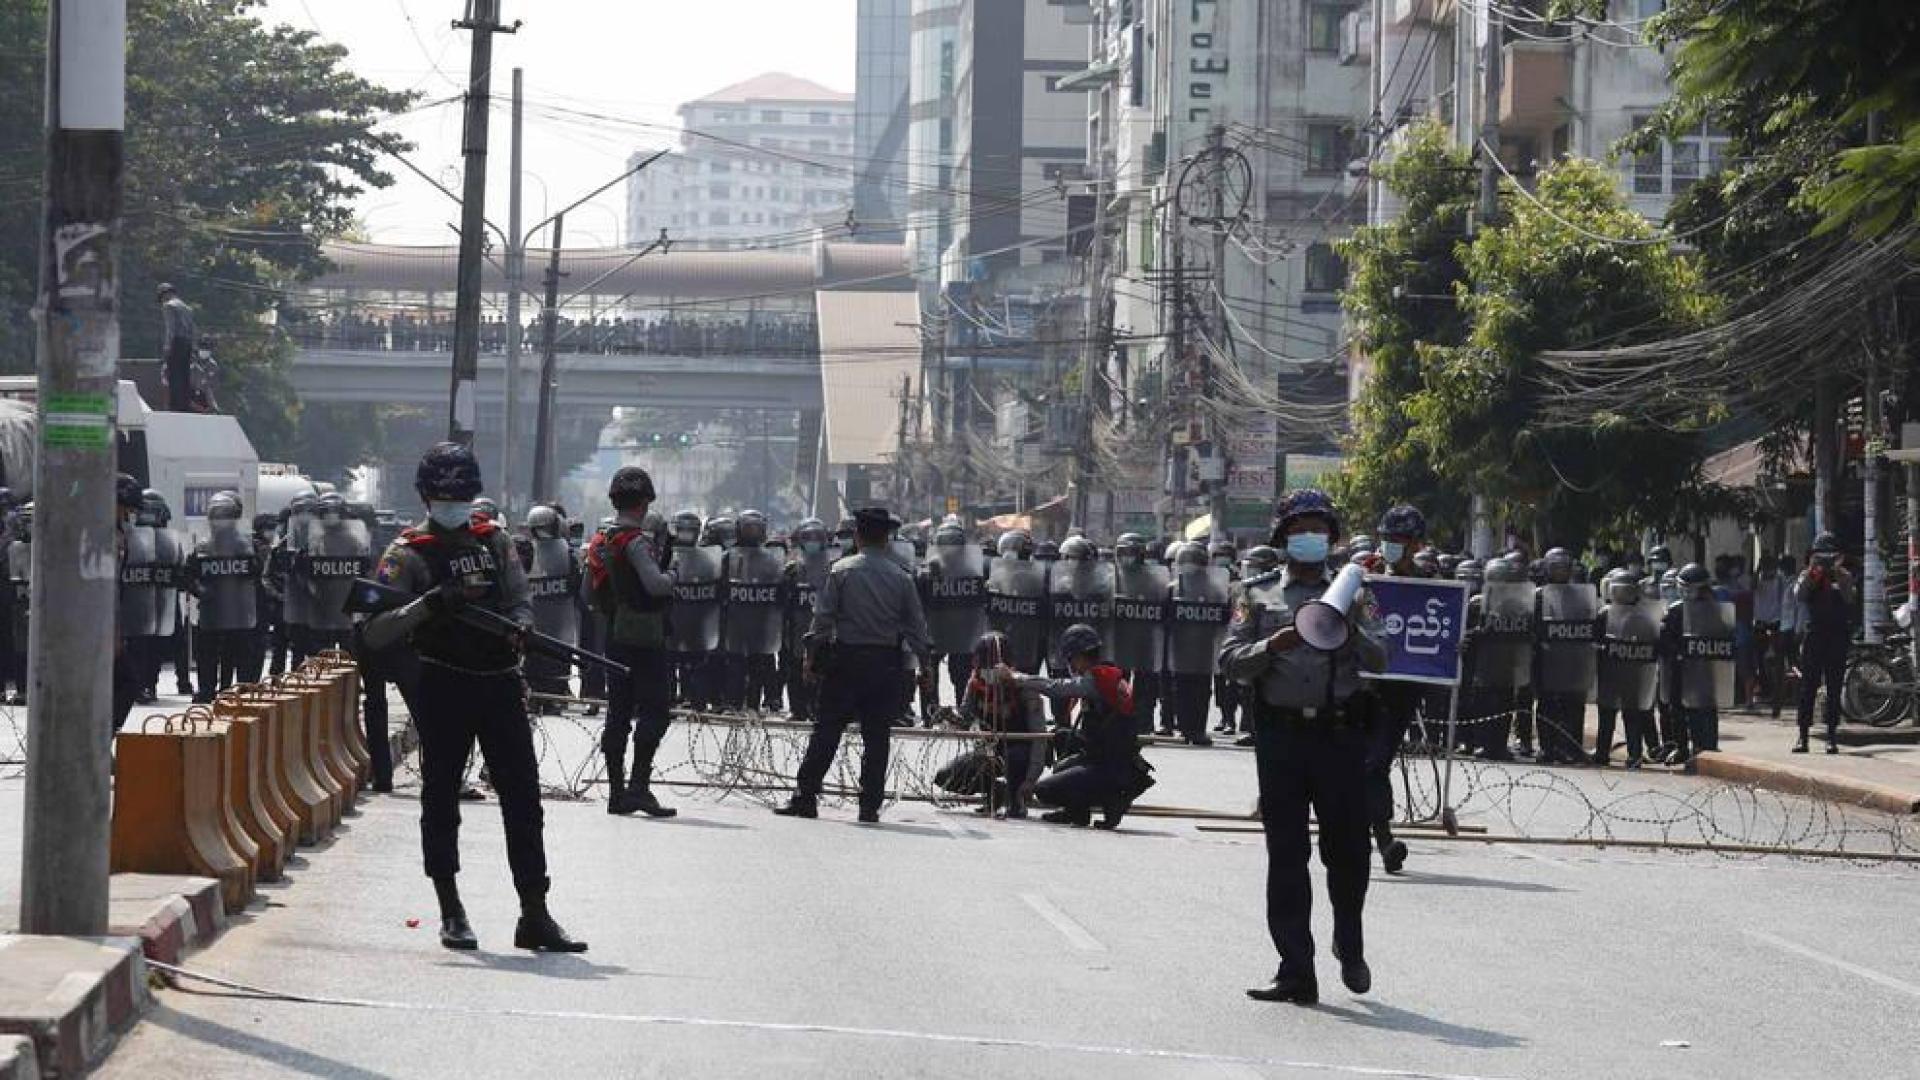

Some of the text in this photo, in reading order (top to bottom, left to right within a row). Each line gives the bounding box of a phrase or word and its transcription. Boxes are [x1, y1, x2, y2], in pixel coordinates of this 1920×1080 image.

[201, 560, 249, 576] POLICE
[312, 562, 361, 575] POLICE
[450, 553, 495, 576] POLIC
[122, 567, 151, 582] LICE
[730, 587, 776, 601] POLICE
[932, 579, 979, 597] POLICE
[990, 598, 1037, 616] POLICE
[1054, 602, 1111, 618] POLICE
[1116, 604, 1162, 620] POLICE
[1176, 606, 1223, 621] POLICE
[1549, 623, 1593, 638] POLICE
[1609, 642, 1655, 658] POLICE
[1688, 639, 1732, 656] POLICE
